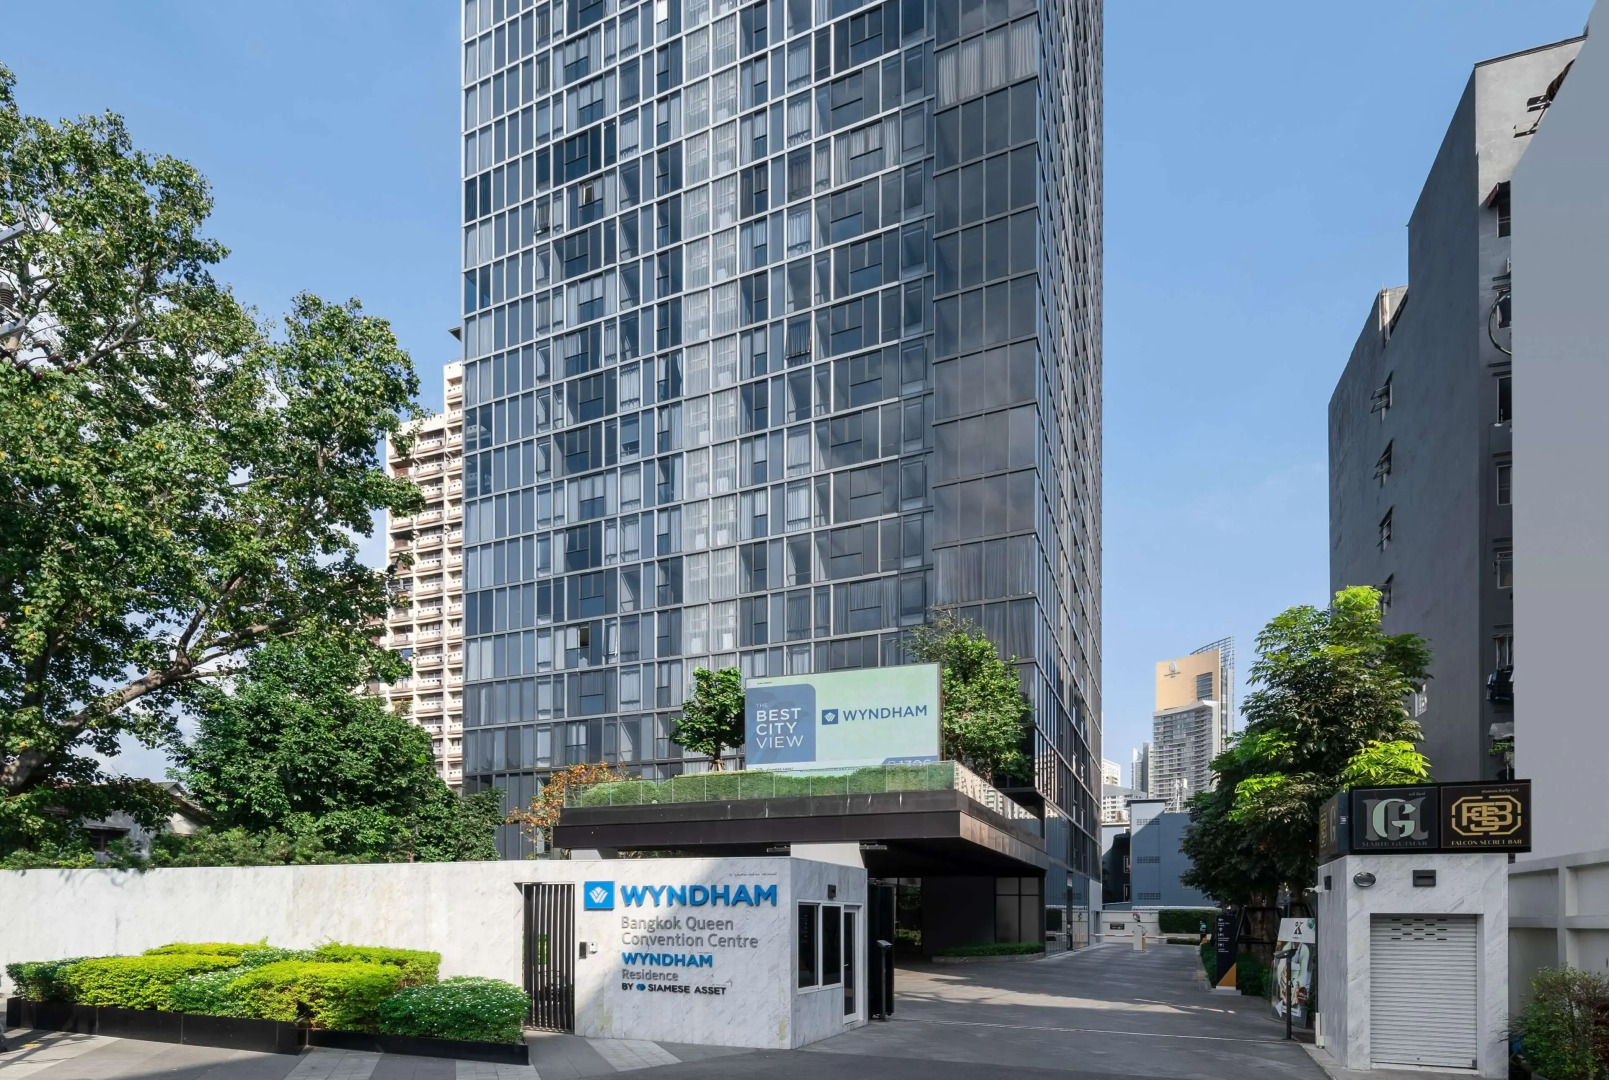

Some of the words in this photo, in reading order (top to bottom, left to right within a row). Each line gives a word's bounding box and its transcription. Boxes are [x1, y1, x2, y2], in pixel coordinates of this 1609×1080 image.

[756, 708, 801, 722] BEST
[843, 705, 927, 721] WYNDHAM
[756, 722, 797, 735] CITY
[756, 736, 804, 749] VIEW
[621, 884, 777, 907] WYNDHAM
[621, 916, 682, 932] Bangkok
[685, 916, 734, 931] Queen
[622, 932, 704, 948] Convention
[708, 933, 759, 949] Centre
[622, 953, 713, 968] WYNDHAM
[622, 968, 679, 982] Residence
[621, 983, 634, 991] BY
[647, 983, 690, 993] SIAMESE
[694, 985, 727, 995] ASSET
